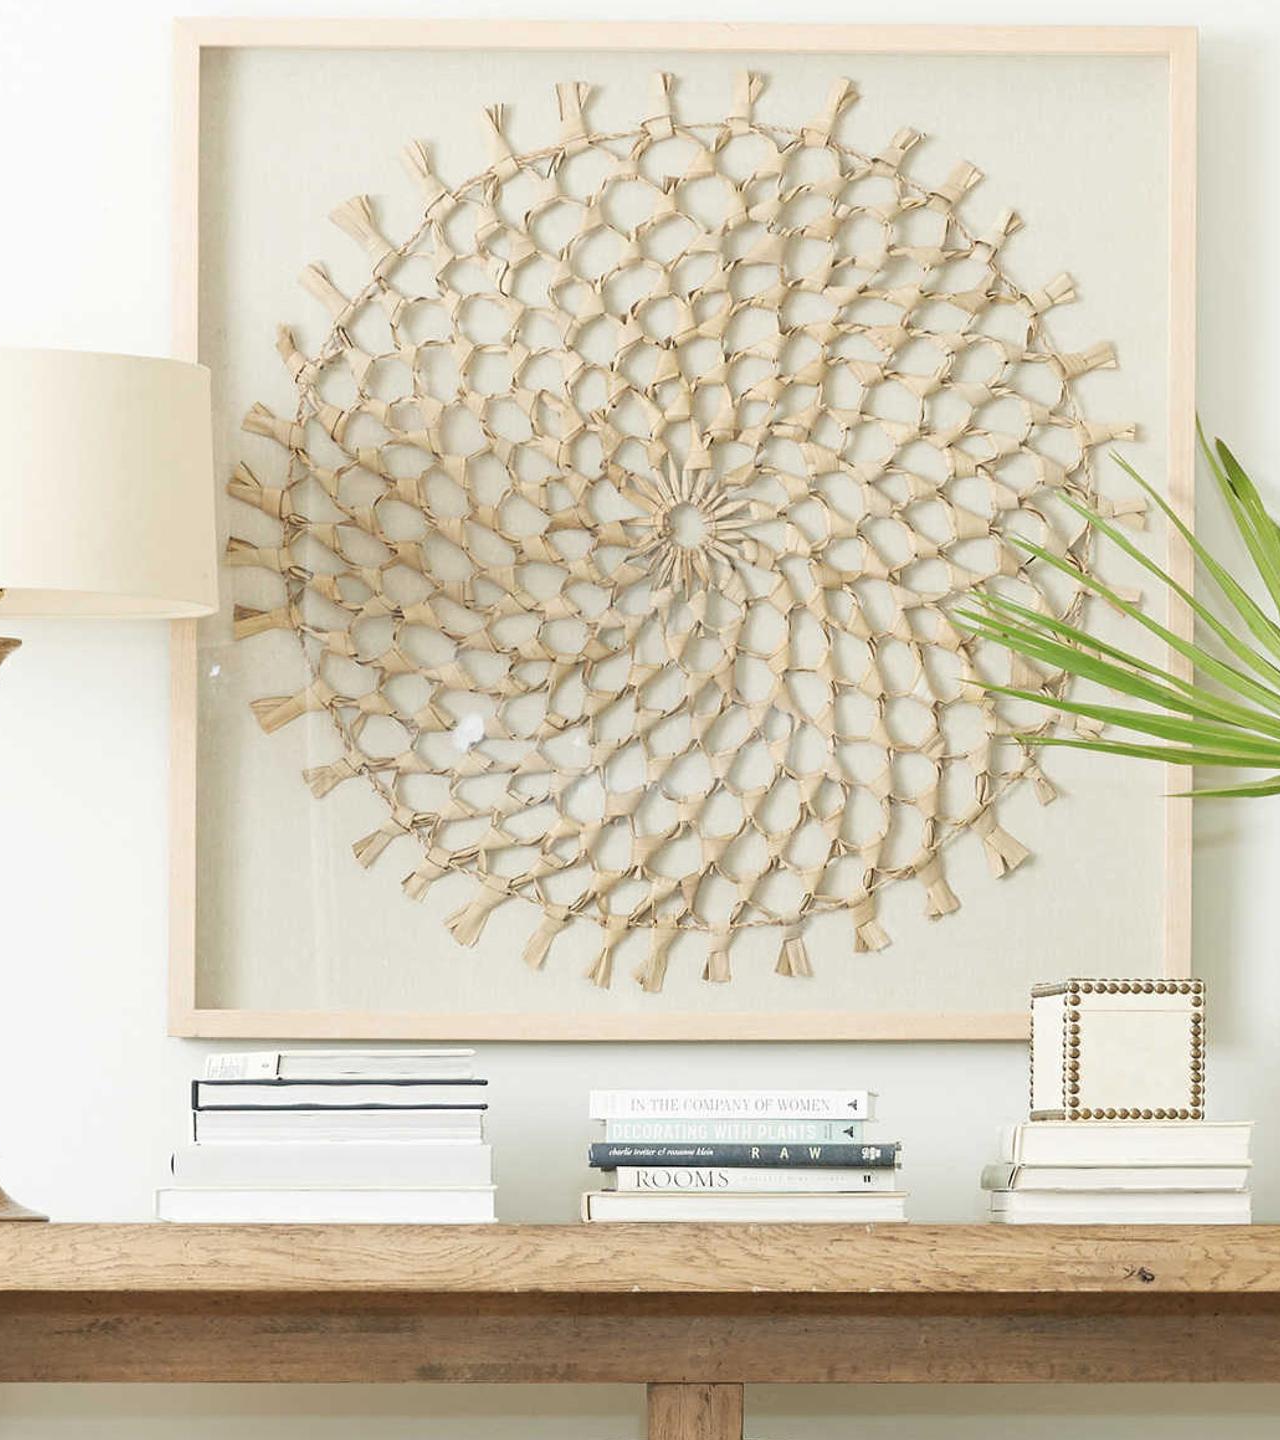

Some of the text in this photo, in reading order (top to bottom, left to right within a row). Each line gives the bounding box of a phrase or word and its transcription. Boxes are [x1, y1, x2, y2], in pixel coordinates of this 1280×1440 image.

[631, 1098, 831, 1112] IN THE COMPANY OF WOMEN
[612, 1123, 708, 1140] DECORATING
[713, 1123, 754, 1139] WITH
[758, 1123, 816, 1140] PLANTS
[636, 1169, 729, 1188] ROOMS
